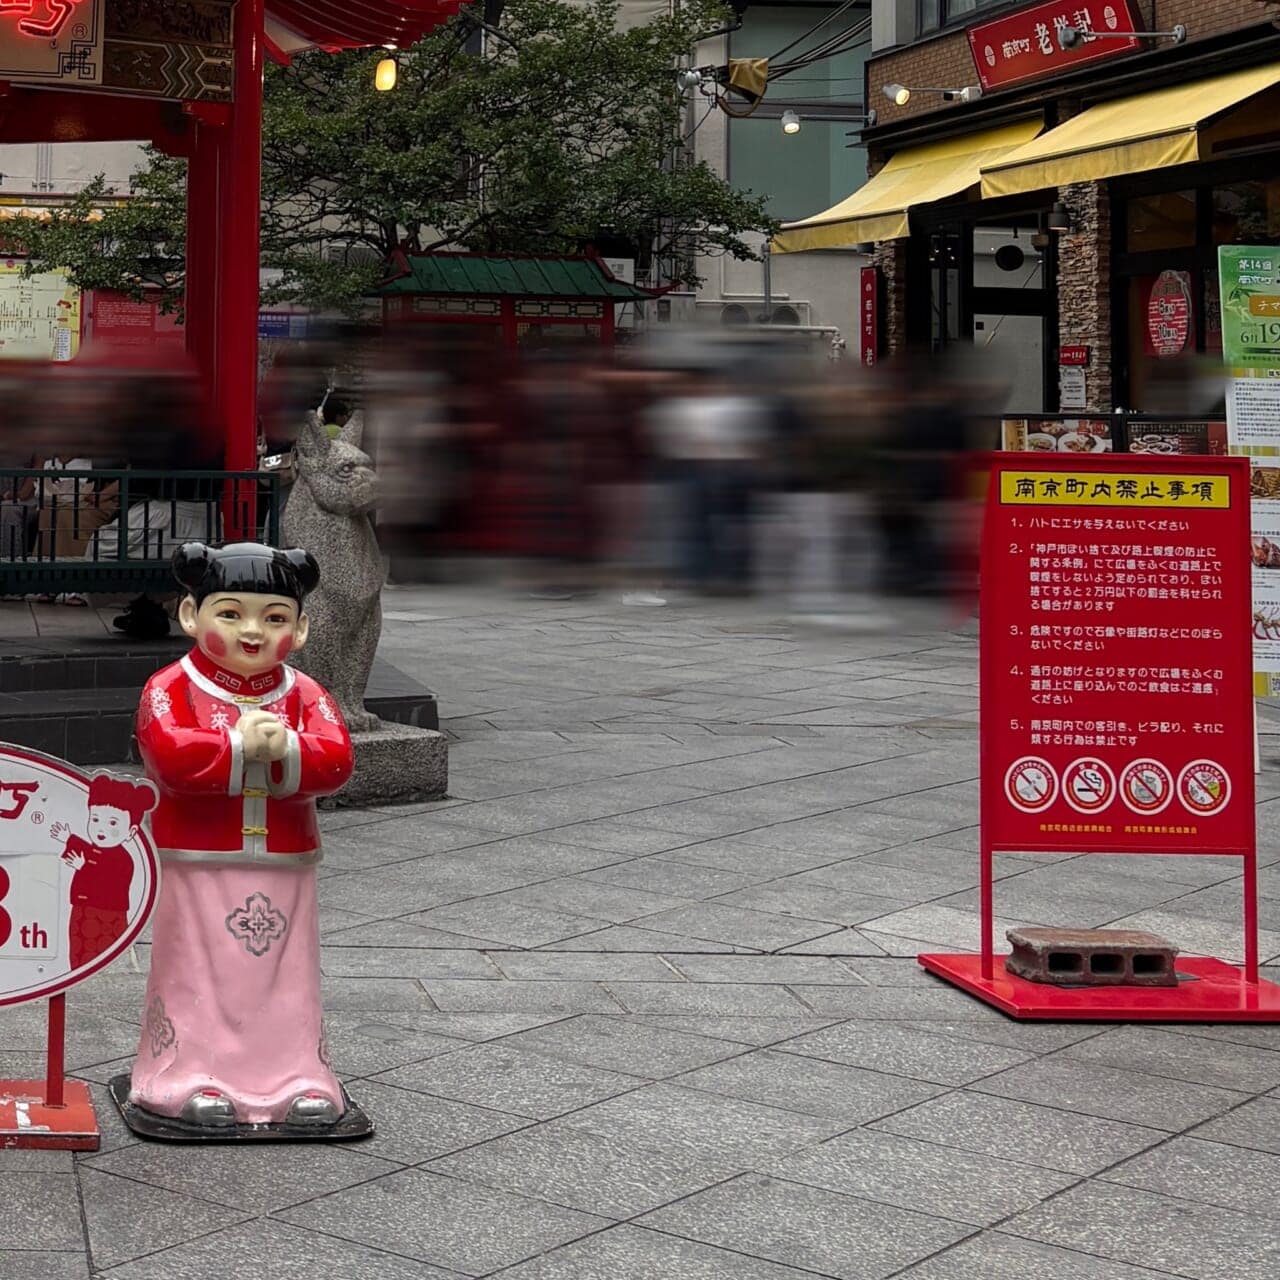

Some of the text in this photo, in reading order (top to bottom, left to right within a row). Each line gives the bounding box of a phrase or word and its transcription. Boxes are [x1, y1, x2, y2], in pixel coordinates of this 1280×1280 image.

[1002, 38, 1030, 59] 南京町
[1014, 477, 1215, 503] 南京町内禁止事項
[1029, 518, 1190, 531] ハトにエサを与えないでください
[1031, 599, 1115, 612] る場合があります
[1030, 639, 1105, 651] ないでください
[1031, 694, 1073, 705] ください
[1031, 733, 1138, 747] 類する行為は禁止です
